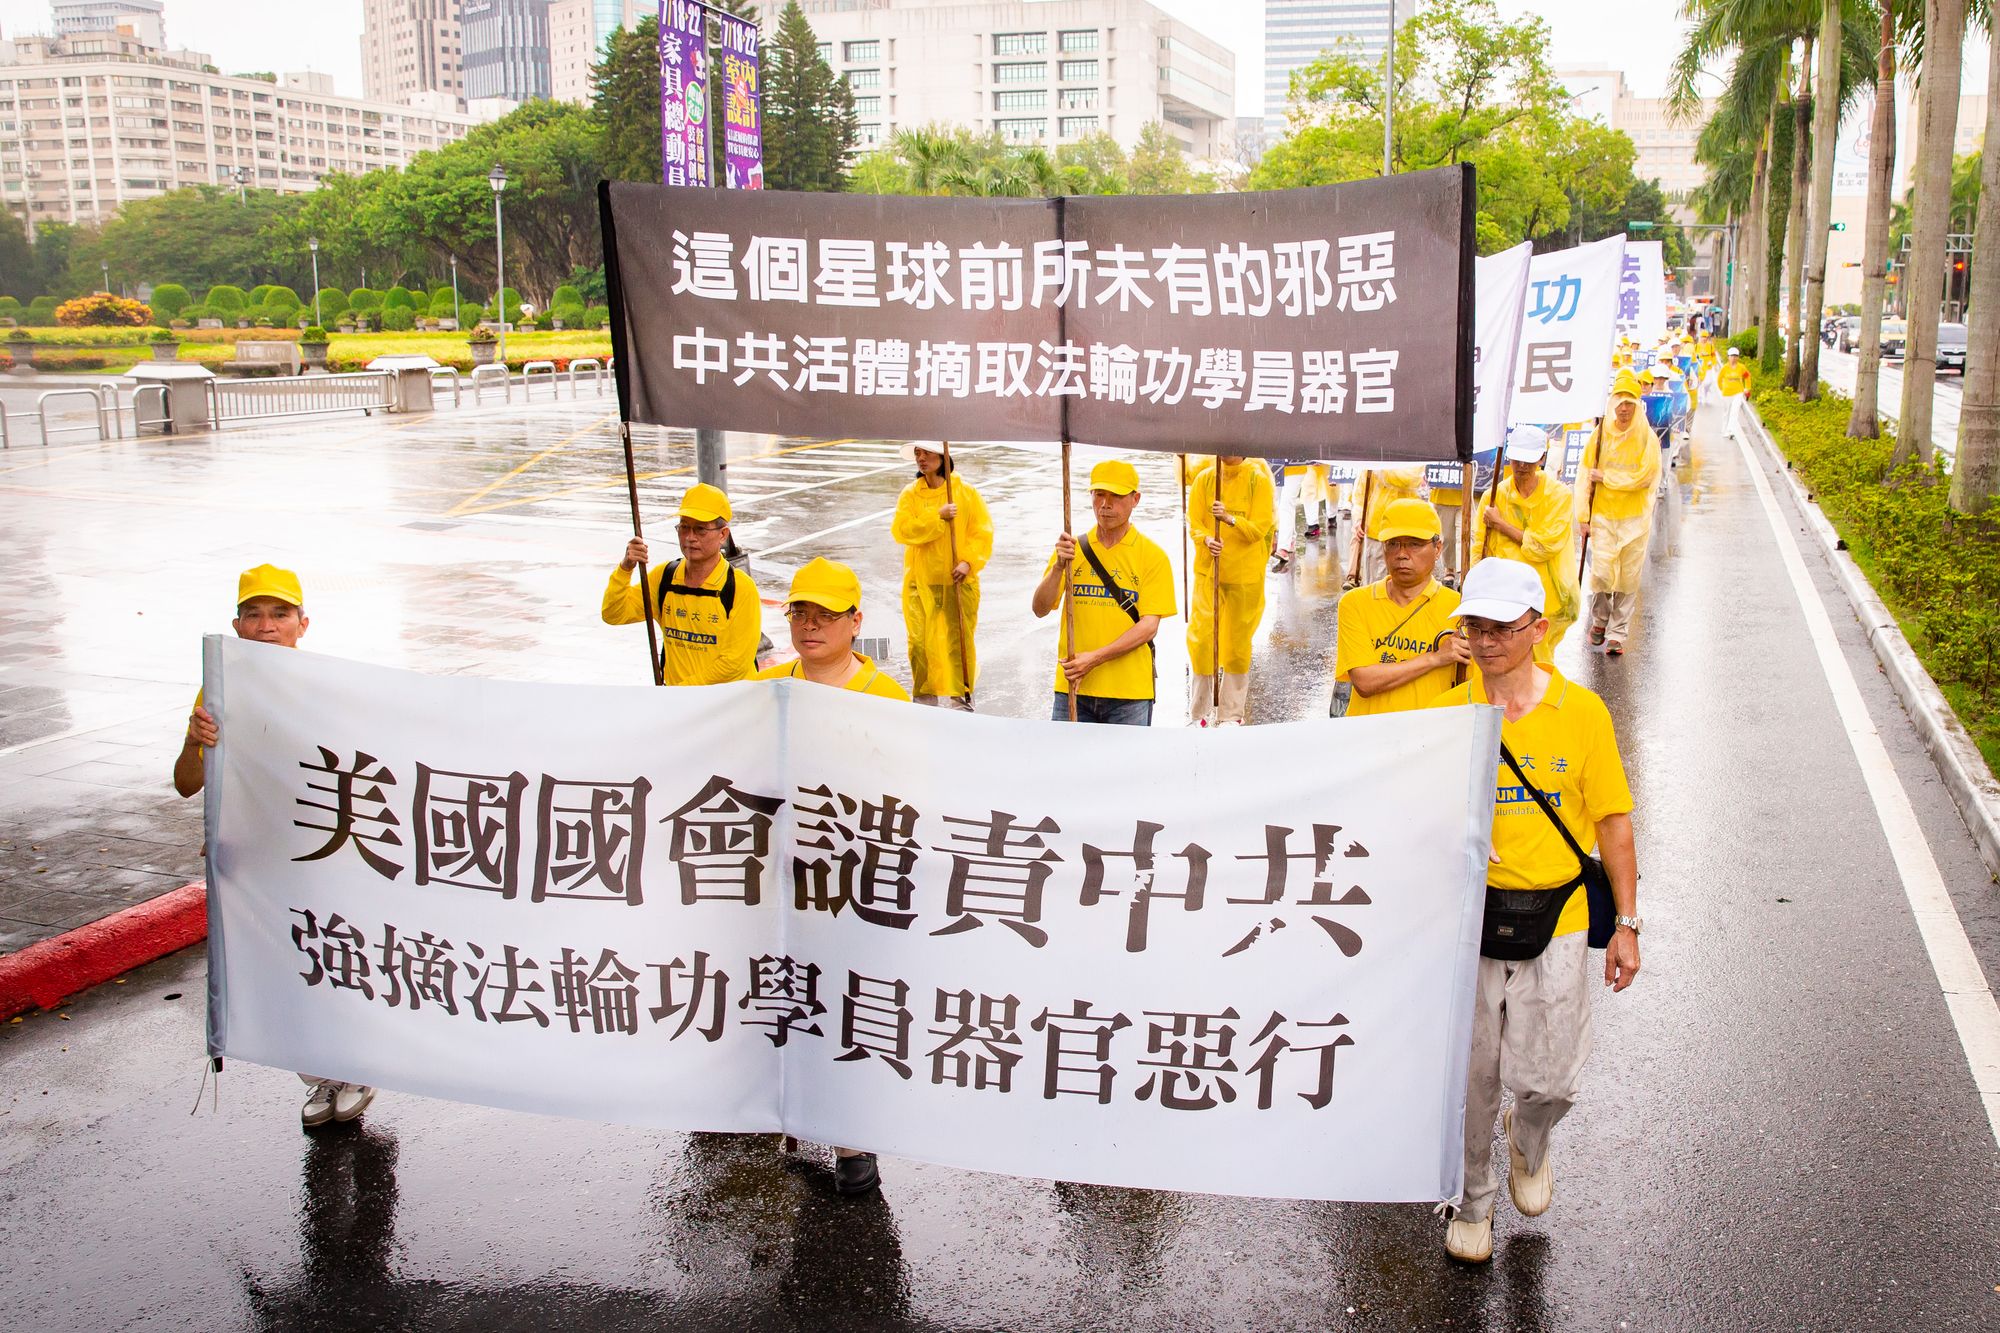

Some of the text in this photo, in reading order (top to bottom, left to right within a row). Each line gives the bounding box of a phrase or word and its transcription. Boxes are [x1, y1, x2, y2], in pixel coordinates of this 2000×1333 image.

[671, 229, 1398, 317] 這個星球前所未有的邪惡
[1528, 274, 1582, 325] 功
[673, 326, 1399, 414] 中共活體摘取法輪功學員器官
[1520, 341, 1573, 393] 民
[290, 745, 1372, 957] 美國國會譴責中共
[289, 906, 1356, 1111] 強摘法輪功學員器官惡行
